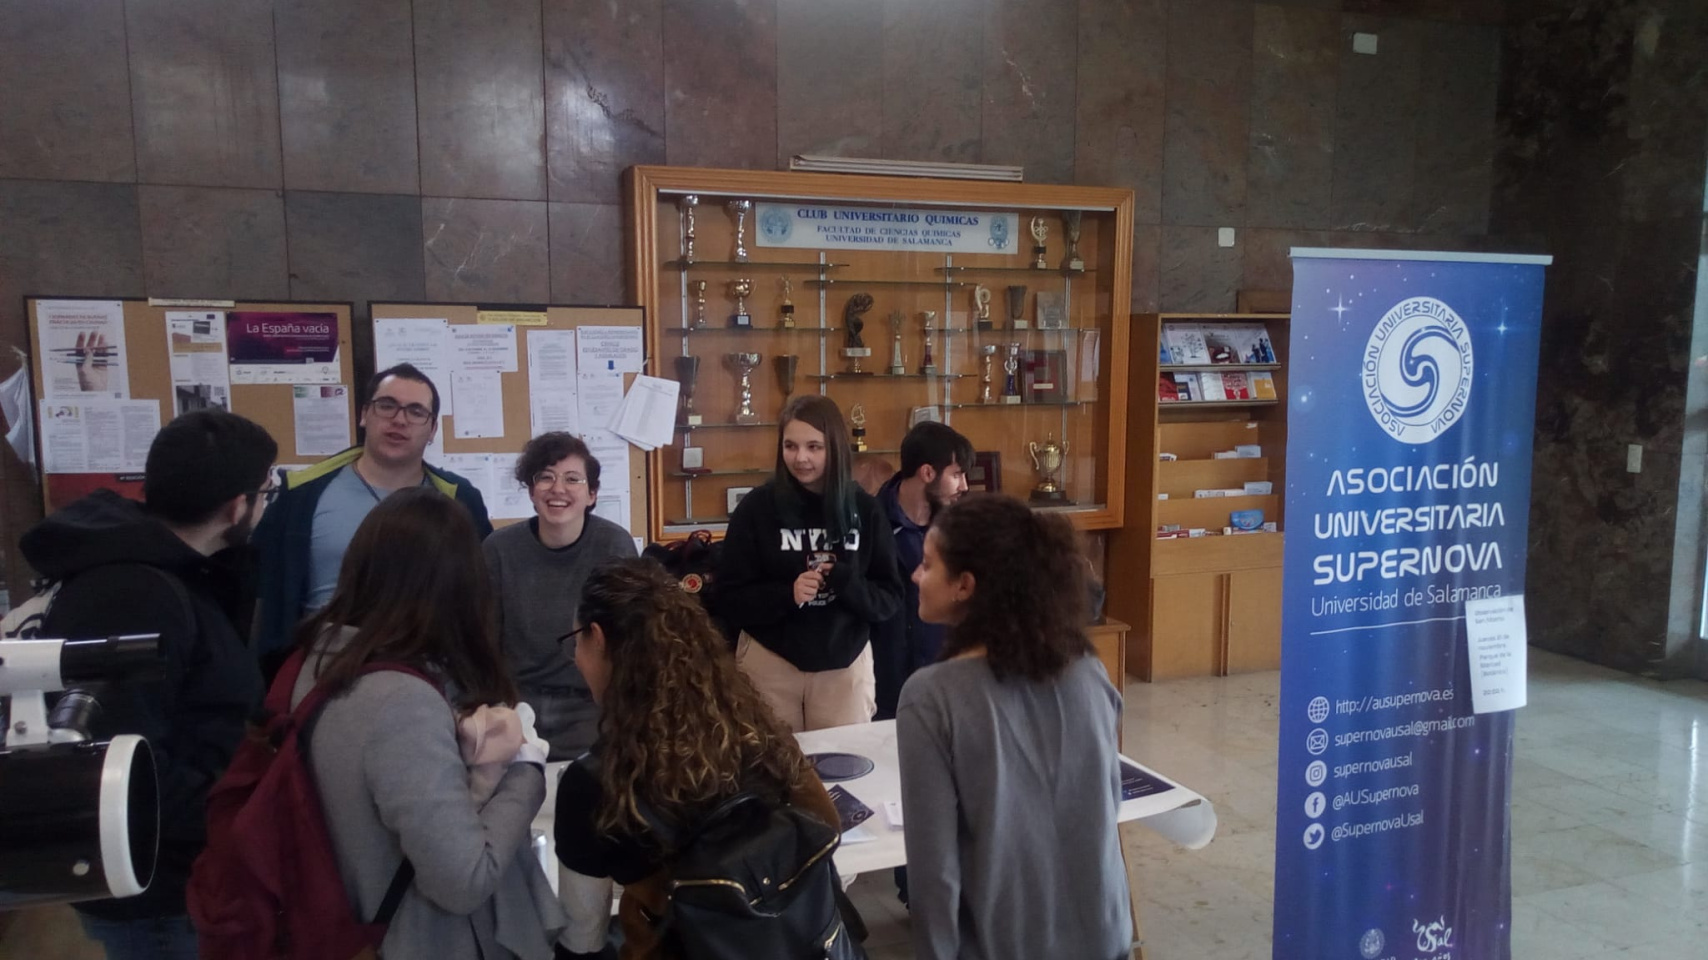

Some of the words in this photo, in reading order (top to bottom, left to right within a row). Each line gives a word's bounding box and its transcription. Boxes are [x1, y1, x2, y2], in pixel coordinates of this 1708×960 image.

[797, 208, 828, 220] CLUB
[833, 211, 919, 223] UNIVERSITARIO
[925, 214, 979, 226] QUIMICAS
[817, 225, 861, 235] FACULTAD
[865, 227, 876, 235] DE
[879, 227, 918, 236] CIENCIAS
[922, 229, 961, 239] QUIMICAS
[826, 234, 883, 244] UNIVERSIDAD
[888, 236, 899, 244] DE
[902, 237, 953, 246] SALAMANCA
[246, 323, 259, 333] La
[262, 323, 300, 335] España
[303, 323, 329, 333] vacía
[1376, 300, 1464, 342] UNIVERSITARIA
[1363, 345, 1405, 436] ASOCIACIÓN
[1431, 342, 1473, 434] SUPERNOVA
[1326, 456, 1499, 496] ASOCIACIÓN
[1314, 502, 1505, 539] UNIVERSITARIA
[1313, 542, 1503, 586] SUPERNOVA
[1311, 588, 1398, 617] Universidad
[1404, 588, 1422, 607] de
[1427, 584, 1501, 605] Salamanca
[1335, 688, 1454, 715] http://ausupernova.es
[1333, 751, 1413, 779] supernovausal
[1332, 784, 1419, 811] @AUSupernova
[1331, 810, 1424, 841] @SupernovaUsal
